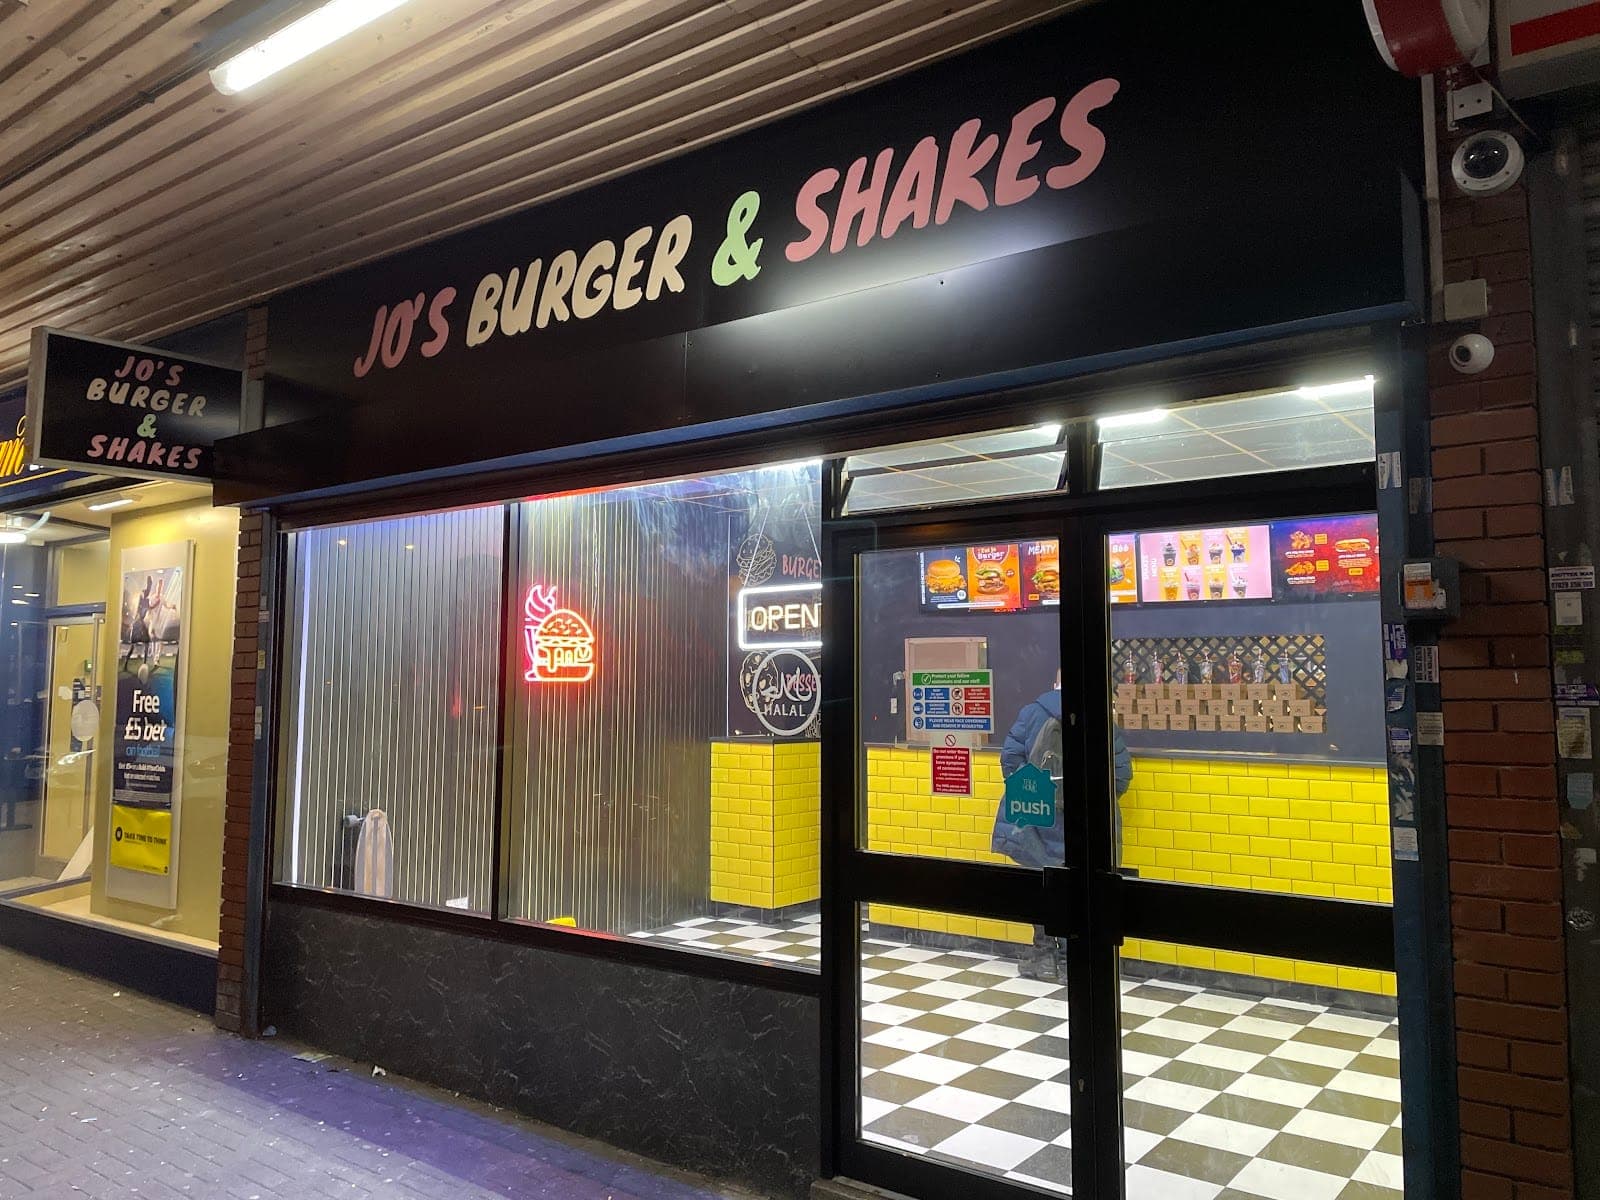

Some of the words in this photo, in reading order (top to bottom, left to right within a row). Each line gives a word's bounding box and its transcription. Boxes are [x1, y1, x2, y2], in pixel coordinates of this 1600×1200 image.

[353, 286, 457, 378] JO'S
[466, 214, 693, 347] BURGER
[711, 190, 764, 287] &
[785, 78, 1121, 262] SHAKES
[115, 356, 184, 386] JO'S
[86, 378, 207, 417] BURGER
[136, 414, 157, 439] &
[86, 434, 202, 470] SHAKES
[751, 603, 819, 631] OPEN
[132, 689, 160, 714] Free
[764, 703, 807, 717] HALAL
[124, 717, 142, 740] £5
[143, 716, 167, 741] bet
[1010, 800, 1051, 816] push
